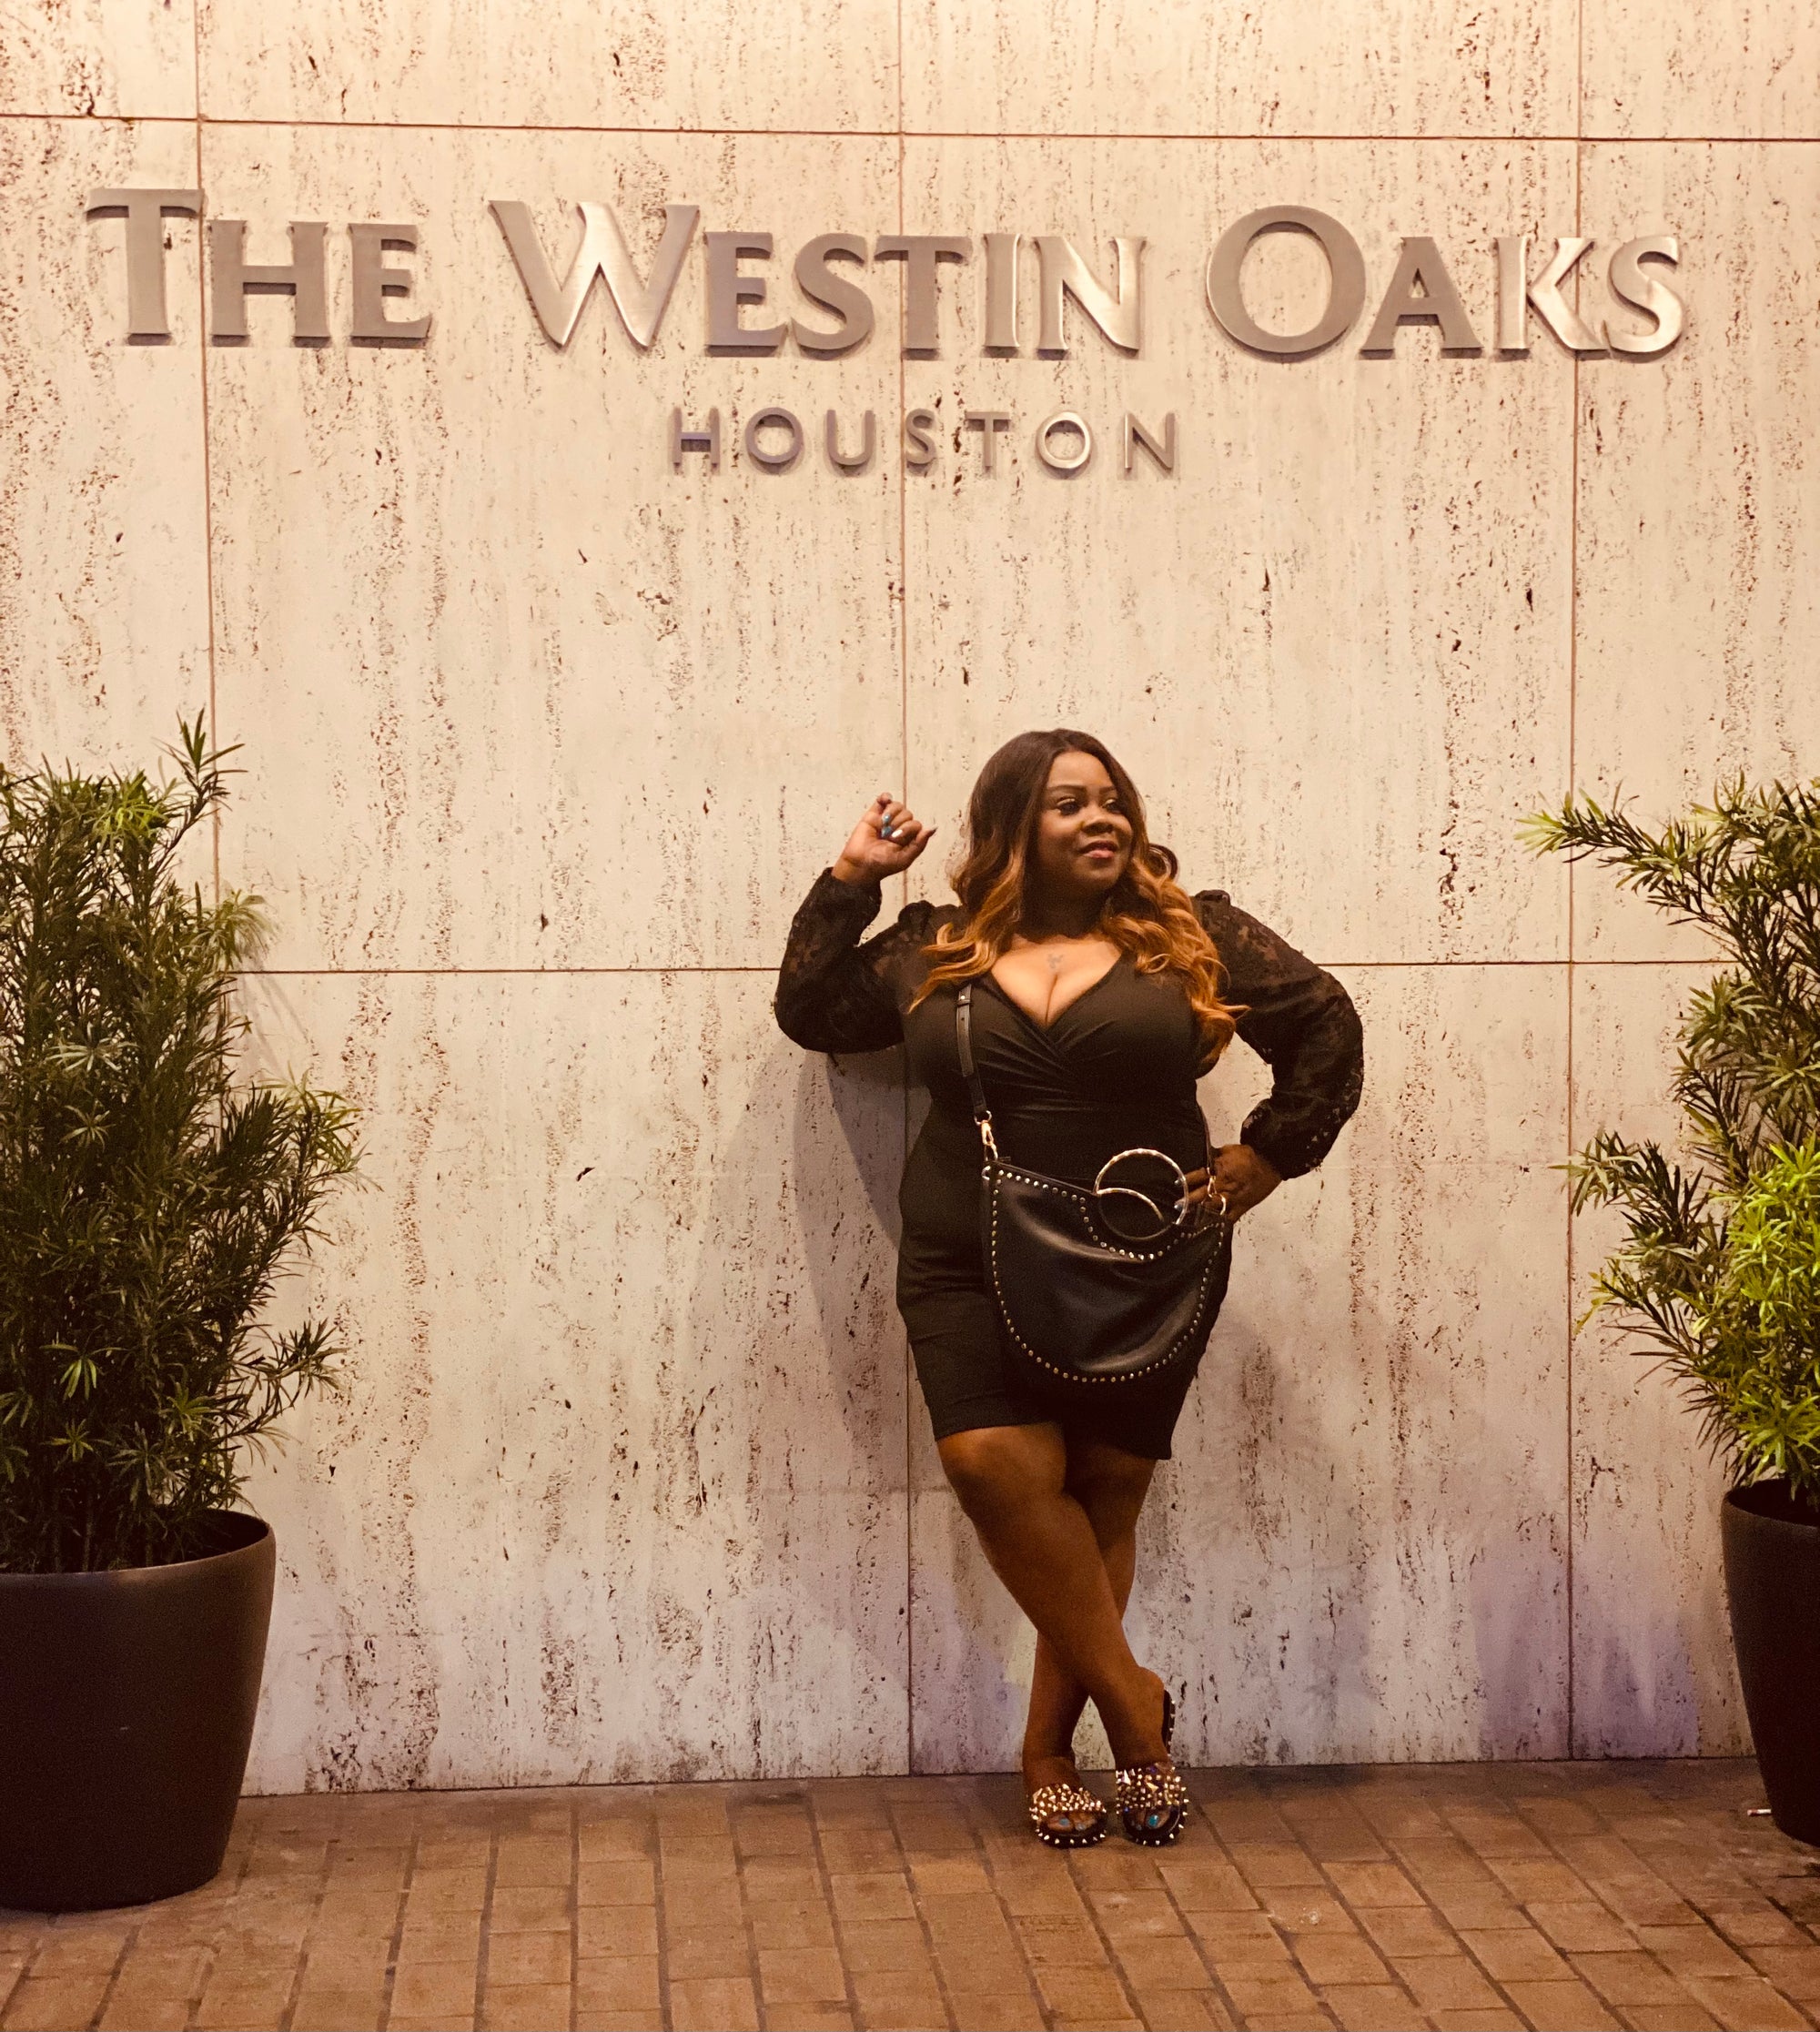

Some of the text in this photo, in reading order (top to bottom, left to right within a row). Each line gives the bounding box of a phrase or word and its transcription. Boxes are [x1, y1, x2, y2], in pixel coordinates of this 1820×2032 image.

[86, 187, 1686, 359] THE WESTIN OAKS
[672, 407, 1178, 474] HOUSTON
